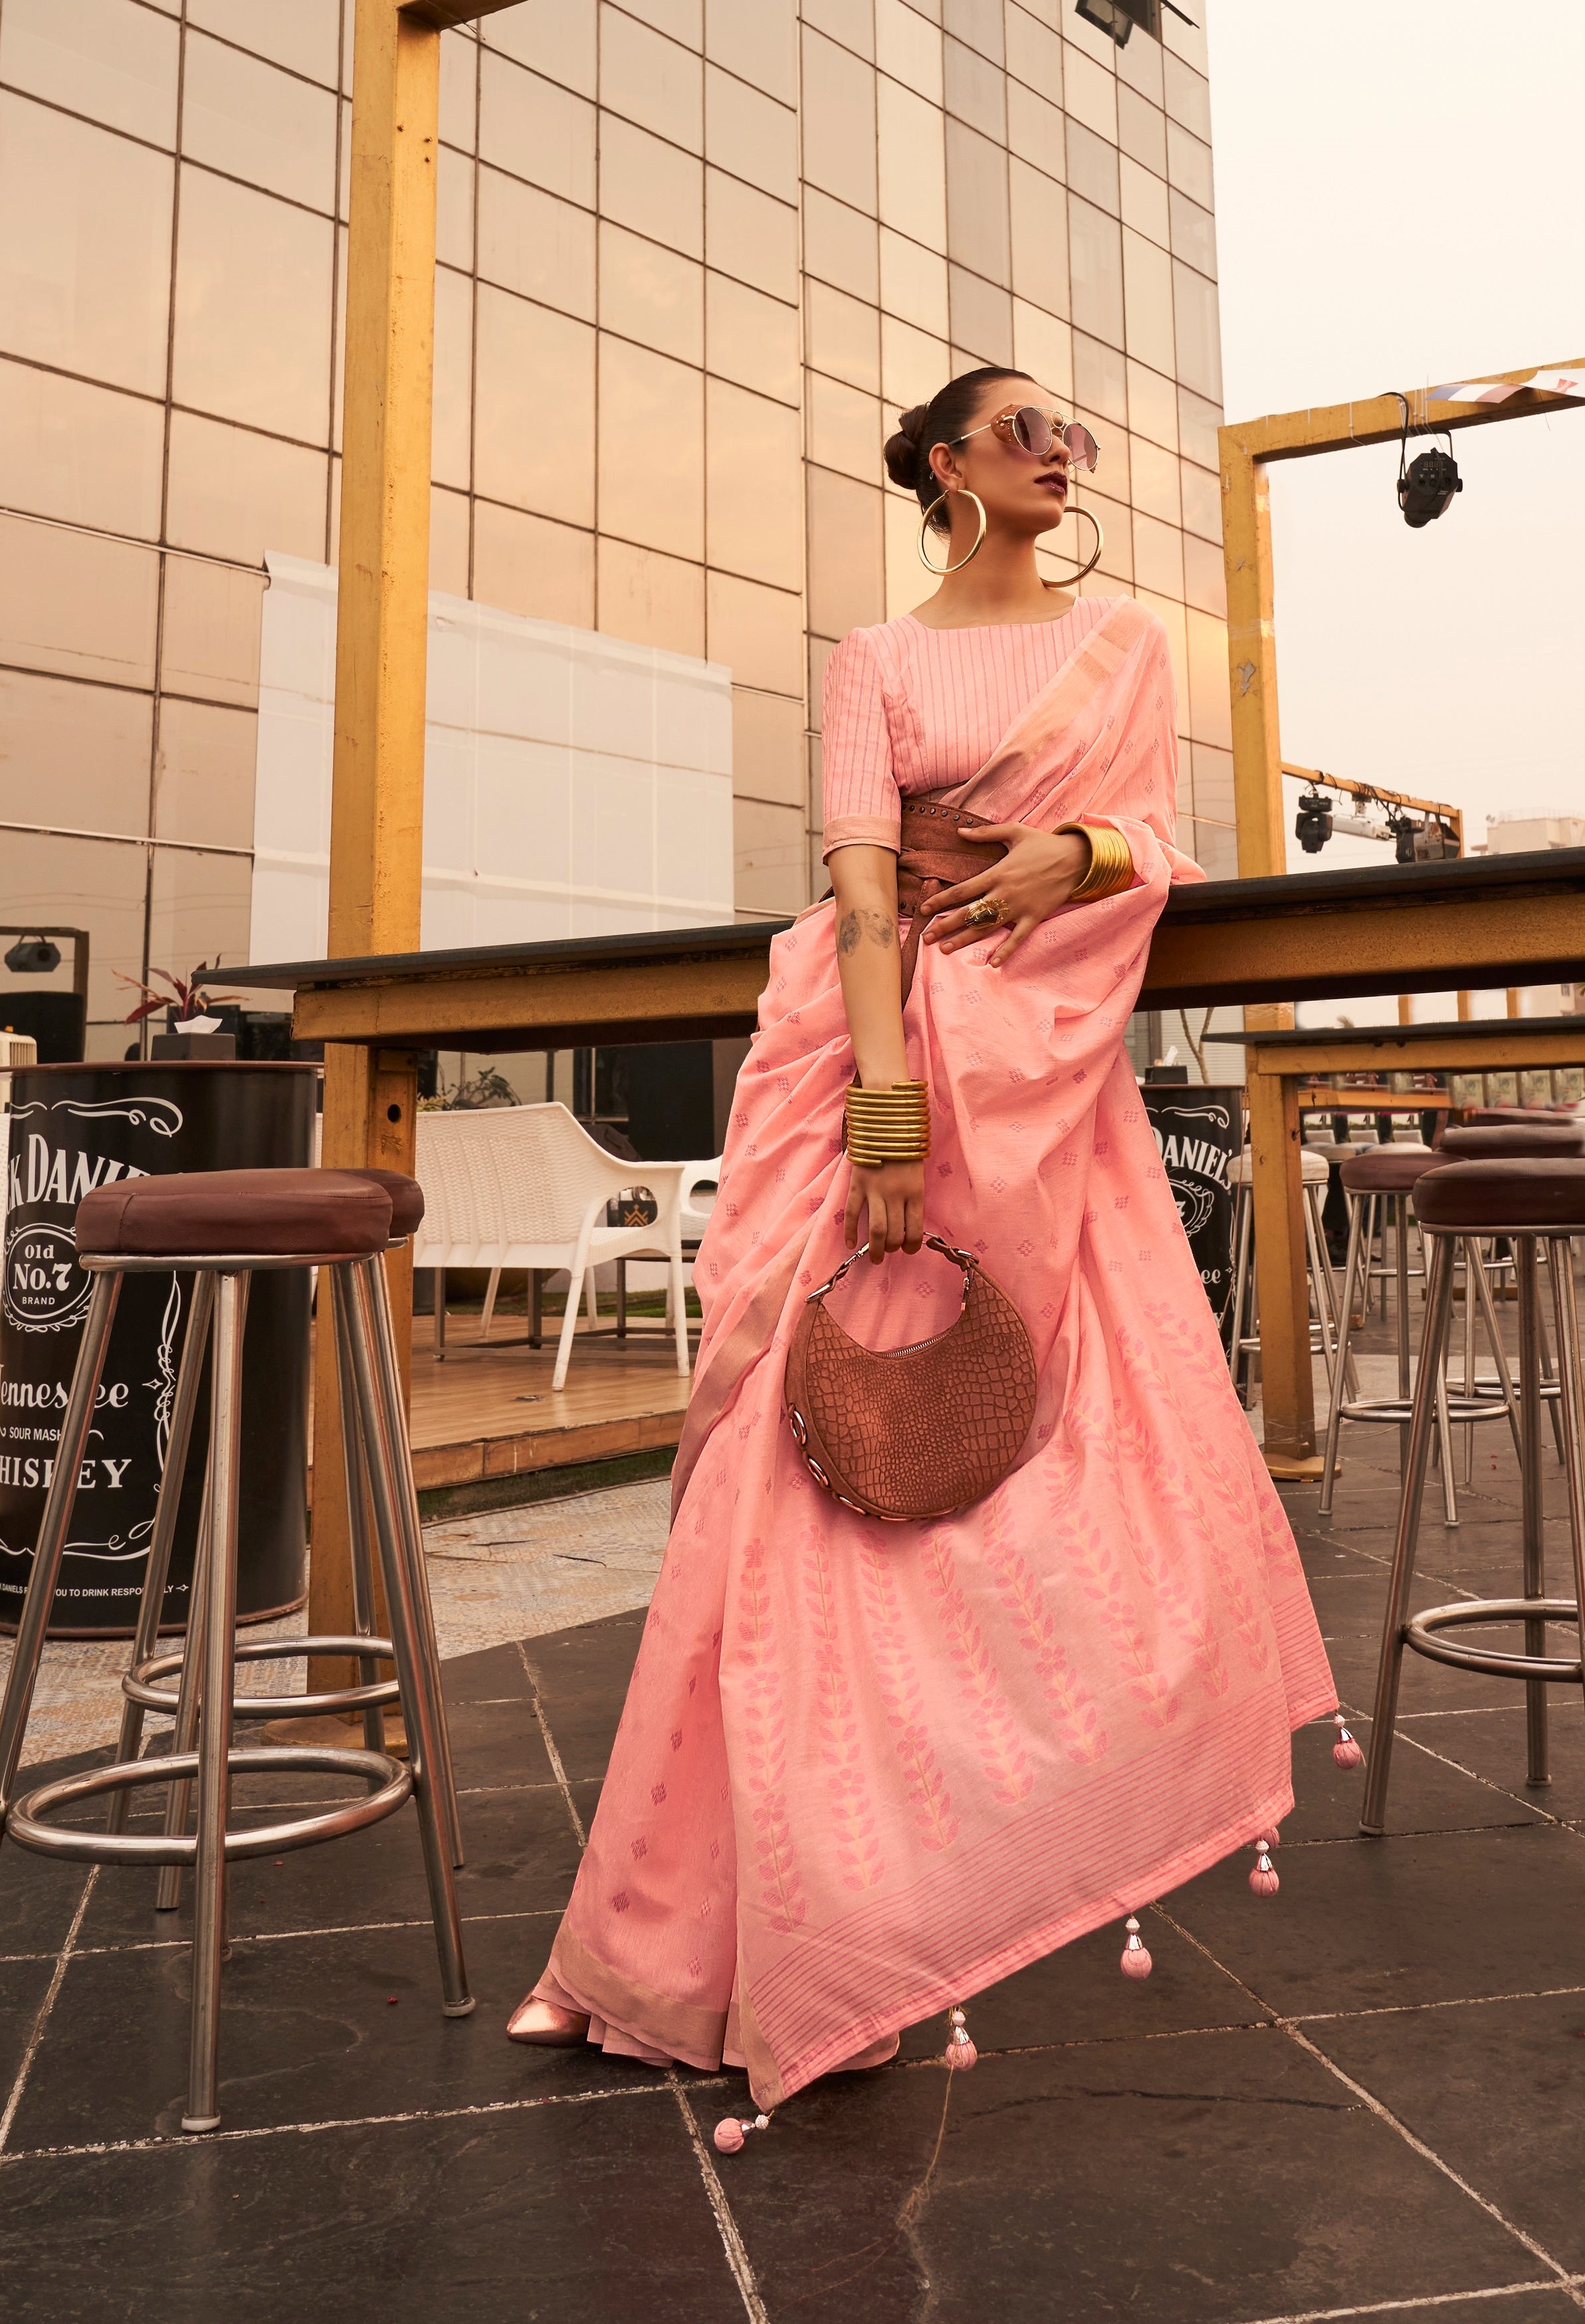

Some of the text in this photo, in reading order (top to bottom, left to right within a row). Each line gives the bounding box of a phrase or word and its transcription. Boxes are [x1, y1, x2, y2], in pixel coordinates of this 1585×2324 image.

[25, 1245, 54, 1259] Old
[13, 1263, 72, 1291] No.7
[9, 1426, 31, 1439] SOUR
[3, 1583, 23, 1594] DANIELS
